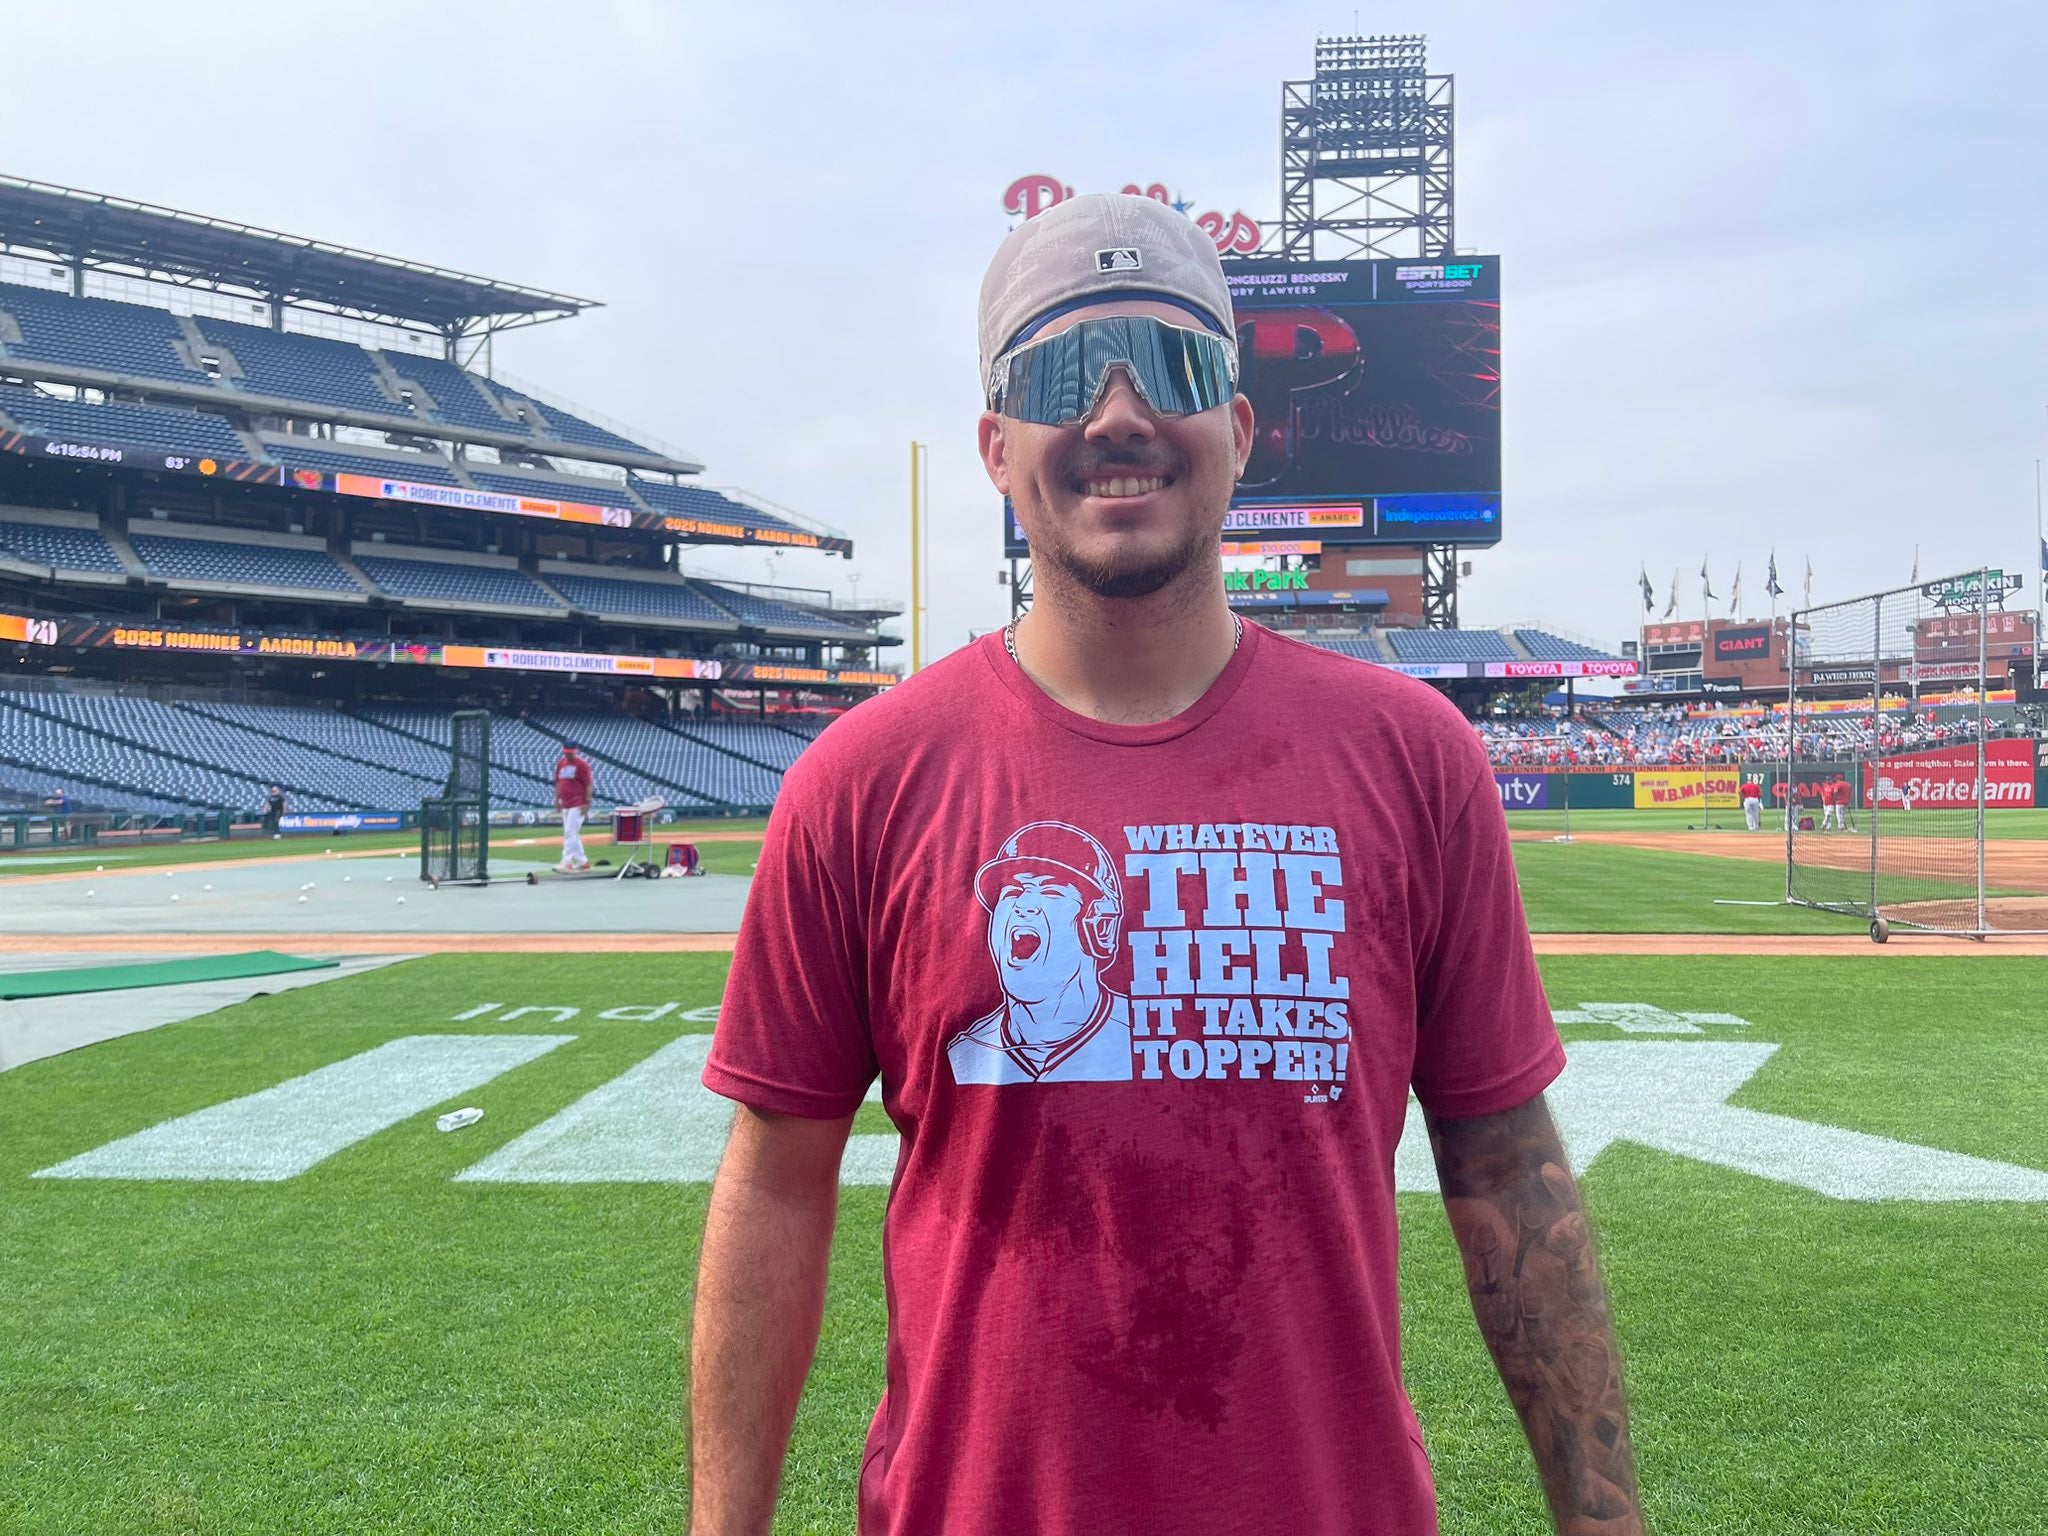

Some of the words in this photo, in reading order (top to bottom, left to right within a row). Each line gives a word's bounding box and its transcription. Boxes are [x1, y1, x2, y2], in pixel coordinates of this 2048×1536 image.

[1225, 274, 1287, 285] ONGELUZZI
[1291, 272, 1350, 284] BENDESKY
[1444, 264, 1483, 280] BET
[1262, 286, 1317, 296] LAWYERS
[1405, 279, 1472, 289] SPORTSBOOK
[100, 447, 123, 463] PM
[409, 485, 463, 503] ROBERTO
[463, 492, 519, 512] CLEMENTE
[1236, 511, 1306, 527] CLEMENTE
[1385, 509, 1478, 523] Independence
[697, 521, 745, 539] NOMINEE
[1260, 543, 1301, 554] $10,000
[1253, 566, 1310, 591] Park
[113, 628, 163, 647] 2025
[165, 631, 241, 651] NOMINEE
[258, 636, 314, 656] AARON
[315, 638, 357, 658] NOLA
[1718, 637, 1766, 652] GIANT
[512, 652, 561, 668] ROBERTO
[562, 656, 614, 672] CLEMENTE
[1508, 663, 1558, 676] TOYOTA
[1586, 661, 1636, 674] TOYOTA
[1712, 684, 1740, 693] Fanatics
[1615, 765, 1668, 773] ASPLUNDH
[1893, 759, 1914, 770] good
[1953, 759, 1975, 768] State
[2006, 759, 2030, 768] there.
[1612, 774, 1631, 786] 374
[1123, 824, 1341, 854] WHATEVER
[1125, 850, 1347, 933] THE
[1128, 929, 1351, 1000] HELL
[452, 1001, 722, 1024] Inde
[1131, 998, 1183, 1037] IT
[1133, 1039, 1350, 1082] TOPPER!
